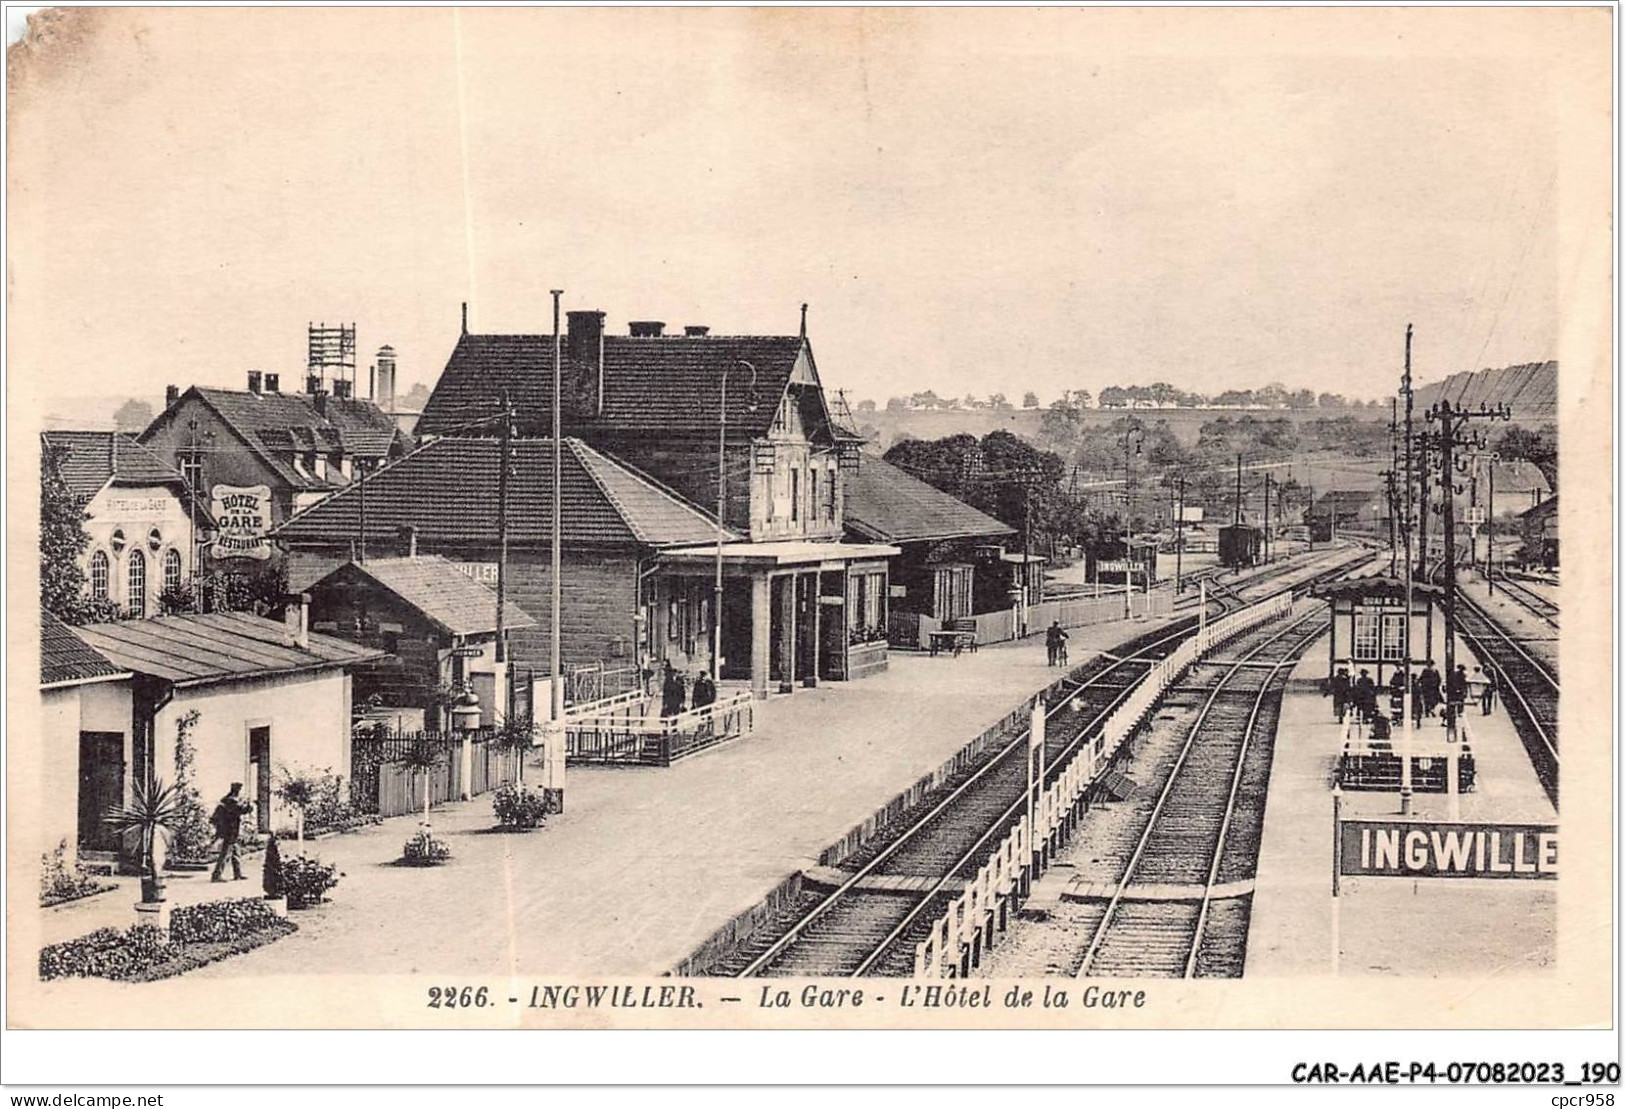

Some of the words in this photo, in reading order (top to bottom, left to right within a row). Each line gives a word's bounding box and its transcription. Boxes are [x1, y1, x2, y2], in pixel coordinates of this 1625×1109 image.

[219, 516, 263, 528] GARE
[217, 534, 266, 550] RESTAURANT
[1361, 828, 1558, 873] INGWILLE
